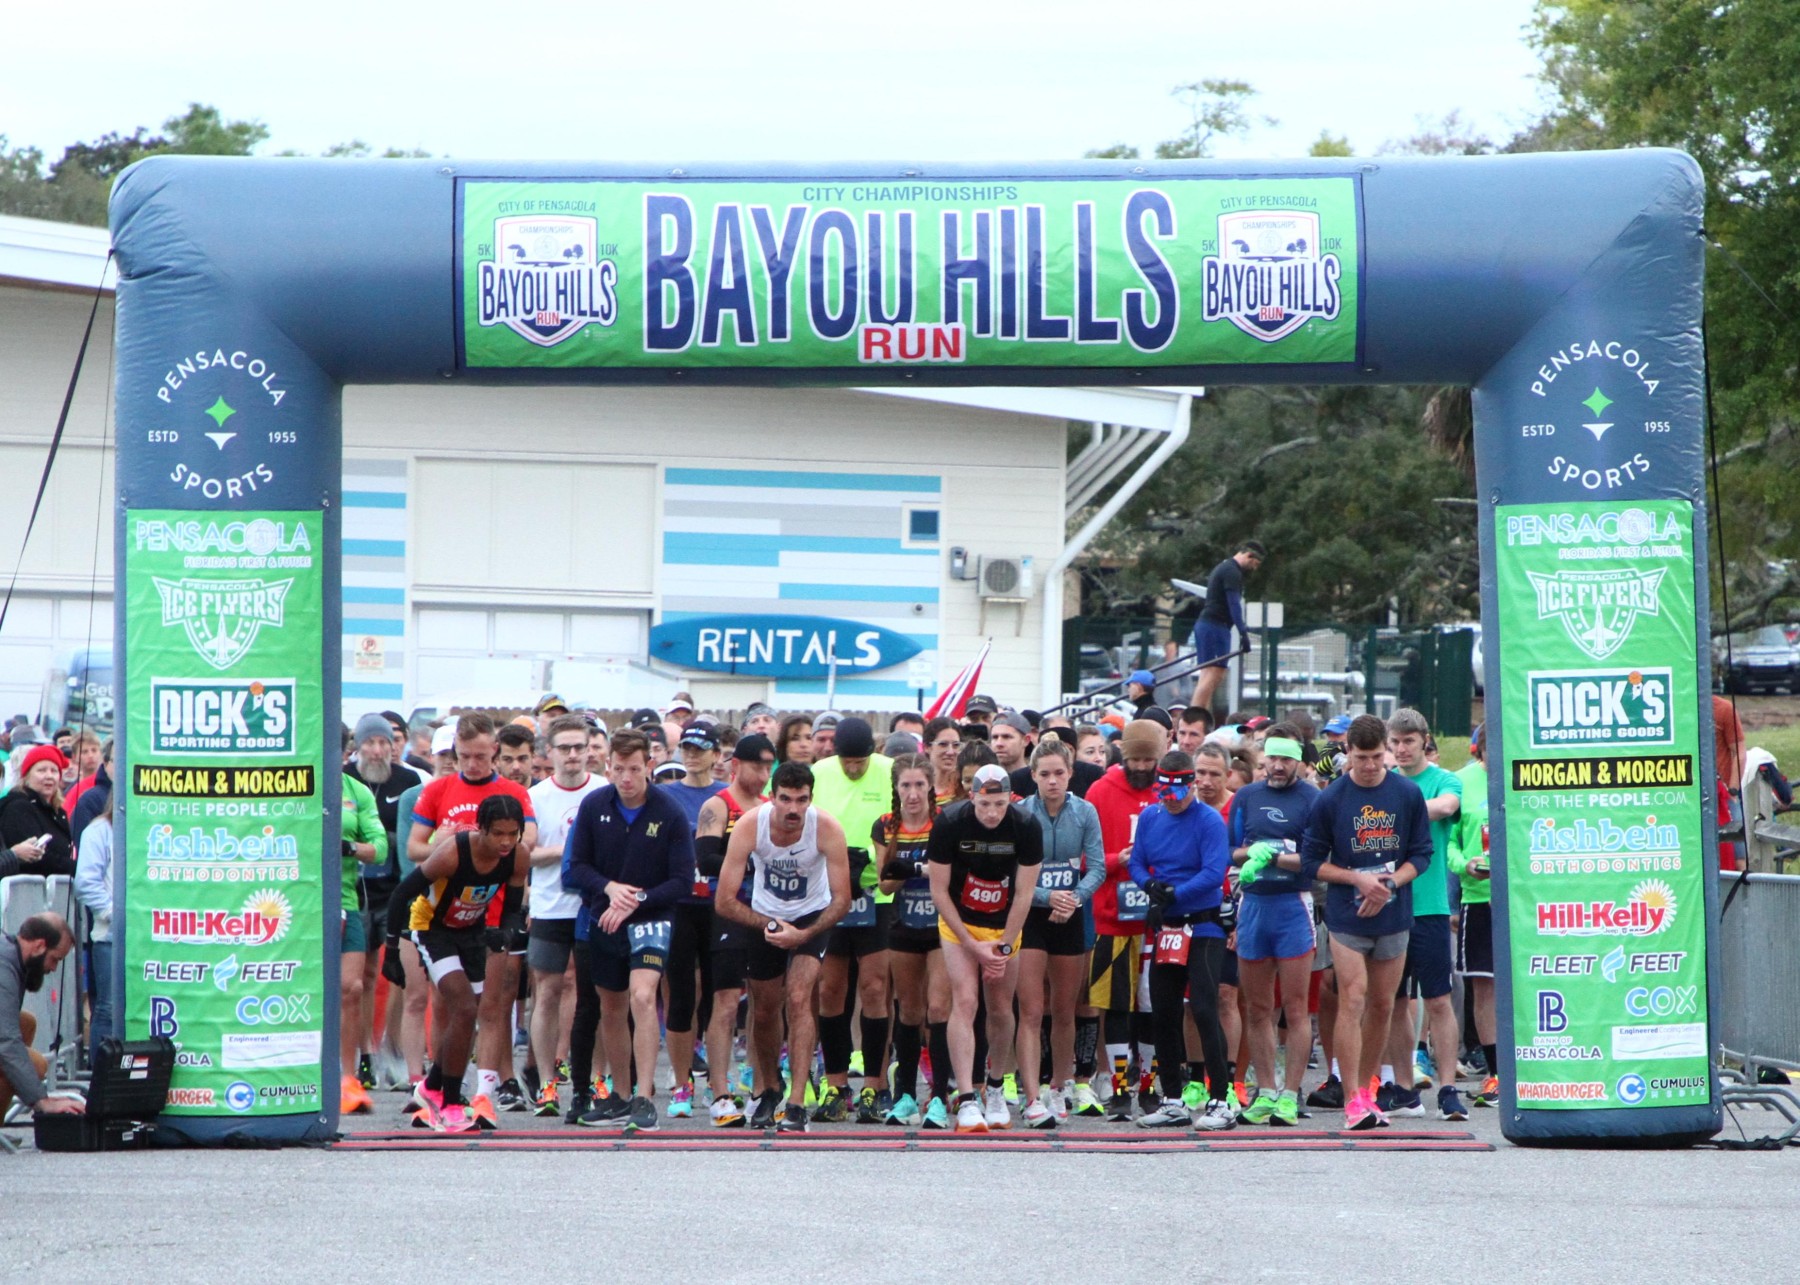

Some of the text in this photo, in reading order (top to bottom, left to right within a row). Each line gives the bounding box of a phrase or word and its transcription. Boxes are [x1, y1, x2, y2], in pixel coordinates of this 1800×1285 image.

[803, 186, 1018, 201] CITY CHAMPIONSHIPS
[499, 200, 596, 213] CITY OF PENSACOLA
[1220, 196, 1317, 209] CITY OF PENSACOLA
[478, 244, 491, 256] 5K
[601, 244, 618, 256] 10K
[1202, 240, 1215, 251] 5K
[1324, 238, 1342, 250] 10K
[646, 190, 1176, 351] BAYOU HILLS
[482, 264, 612, 321] BAYOU HILLS
[1207, 258, 1335, 316] BAYOU HILLS
[536, 312, 560, 325] RUN
[1260, 307, 1283, 320] RUN
[864, 327, 961, 360] RUN
[1531, 339, 1660, 397] PENSACOLA
[157, 348, 286, 406] PENSACOLA
[1522, 424, 1555, 437] ESTD
[1644, 421, 1671, 433] 1955
[148, 430, 178, 443] ESTD
[268, 431, 297, 444] 1955
[1548, 453, 1650, 489] SPORTS
[170, 463, 273, 499] SPORTS
[1507, 508, 1682, 546] PENSACOLA
[136, 518, 311, 556] PENSACOLA
[1561, 572, 1633, 581] PENSACOLA
[698, 628, 881, 667] RENTALS
[159, 688, 287, 736] DICK'S
[1537, 679, 1665, 728] DICK'S
[160, 736, 286, 748] SPORTING GOODS
[1540, 727, 1665, 740] SPORTING GOODS
[139, 768, 308, 794] MORGAN & MORGAN
[1519, 759, 1687, 787] MORGAN & MORGAN
[140, 802, 167, 816] FOR
[171, 802, 201, 816] THE
[1521, 795, 1549, 809] FOR
[1553, 794, 1584, 808] THE
[1353, 813, 1396, 830] NOW
[147, 824, 298, 860] fishbein
[1530, 815, 1681, 852] fishbein
[1351, 834, 1400, 851] LATER
[1530, 857, 1681, 874] ORTHODONTICS
[147, 867, 299, 882] ORTHODONTICS
[769, 873, 799, 891] 810
[1042, 870, 1073, 887] 878
[969, 888, 1002, 903] 490
[1125, 891, 1150, 907] 82
[905, 900, 935, 915] 745
[1538, 902, 1665, 935] Hill-Kelly
[153, 911, 279, 944] Hill-Kelly
[634, 922, 664, 939] 811
[1160, 934, 1182, 951] 478
[144, 961, 298, 982] FLEET FEET
[1530, 953, 1683, 976] FLEET FEET
[1625, 985, 1697, 1016] COX
[236, 994, 312, 1025] COX
[229, 1035, 269, 1043] Engineered
[1619, 1027, 1659, 1035] Engineered
[1534, 1036, 1572, 1045] BANK OF
[1517, 1046, 1602, 1060] PENSACOLA
[259, 1084, 317, 1097] CUMULUS
[1518, 1083, 1605, 1099] WHATABURGER
[1650, 1076, 1705, 1089] CUMULUS
